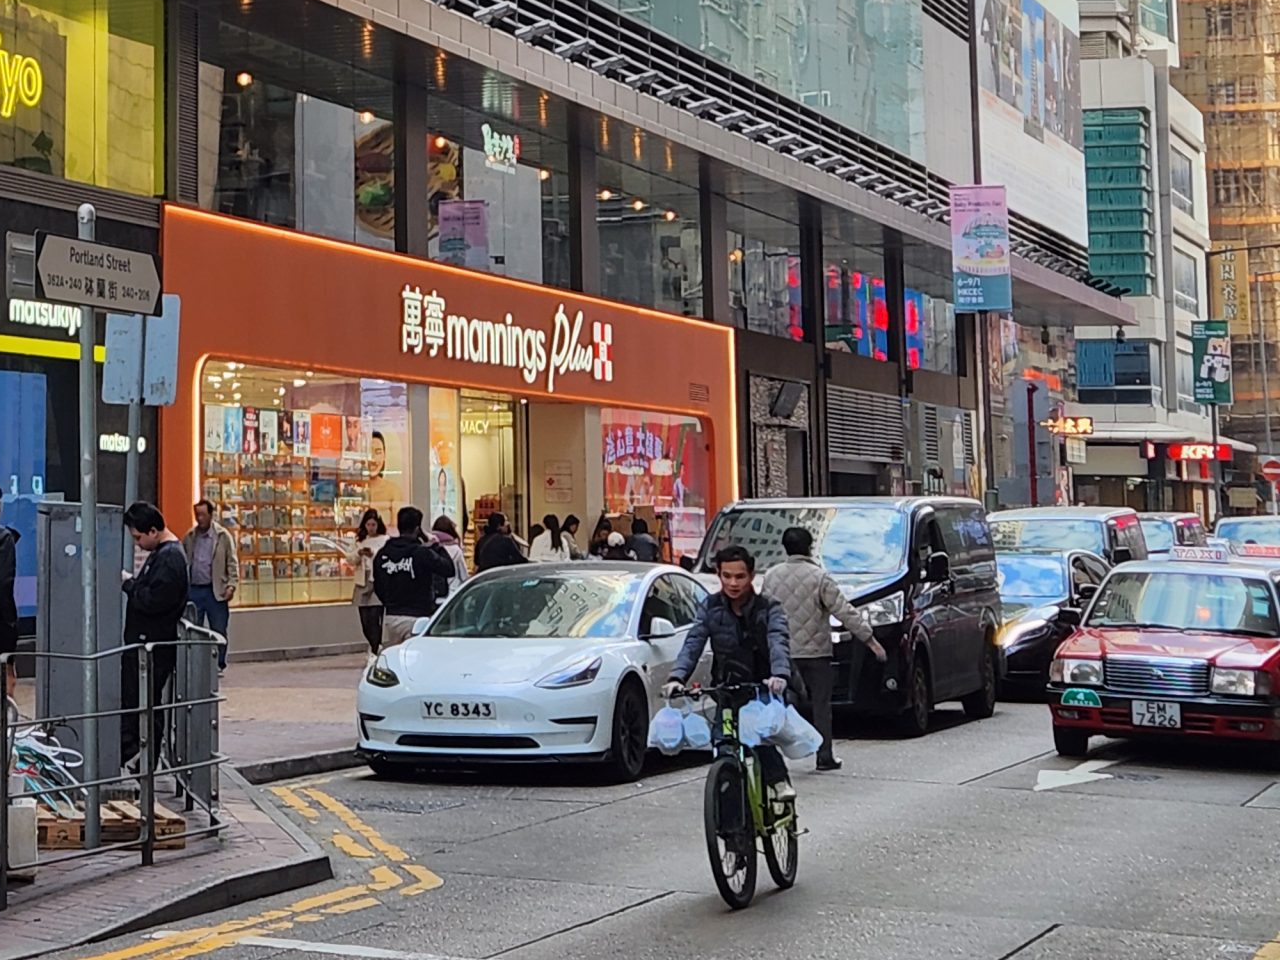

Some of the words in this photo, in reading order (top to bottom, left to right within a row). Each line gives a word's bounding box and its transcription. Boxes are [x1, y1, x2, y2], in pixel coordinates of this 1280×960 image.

[69, 246, 104, 268] Portland
[106, 253, 131, 273] Street
[402, 284, 446, 357] 萬寧
[447, 313, 547, 383] mannings
[1174, 547, 1223, 560] TAXI
[424, 701, 443, 716] YC
[450, 702, 492, 717] 8343
[1146, 702, 1167, 715] EM
[1136, 713, 1178, 728] 7426
